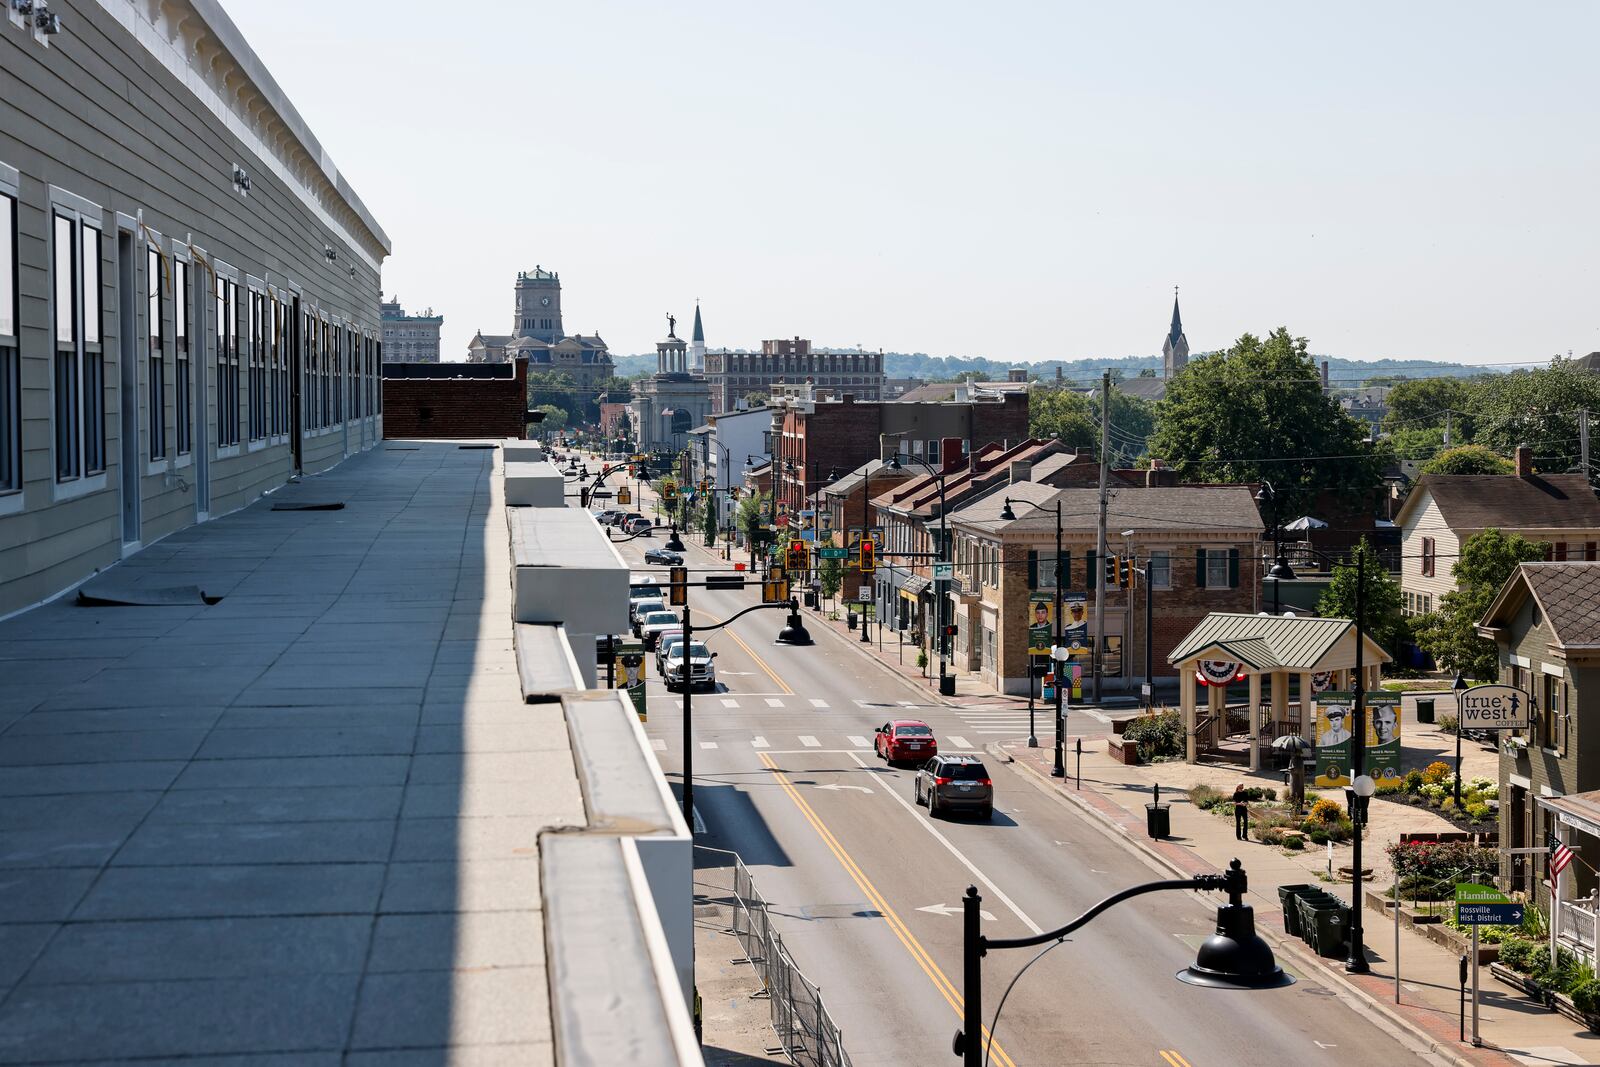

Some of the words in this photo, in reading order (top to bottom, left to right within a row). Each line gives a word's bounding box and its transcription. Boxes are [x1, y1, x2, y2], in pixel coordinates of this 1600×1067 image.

[935, 565, 944, 577] P
[1465, 695, 1501, 708] true
[1465, 707, 1507, 720] west
[1458, 890, 1501, 900] Hamilton
[1460, 906, 1491, 914] Rossville
[1460, 914, 1475, 922] Hist.
[1477, 914, 1502, 922] District
